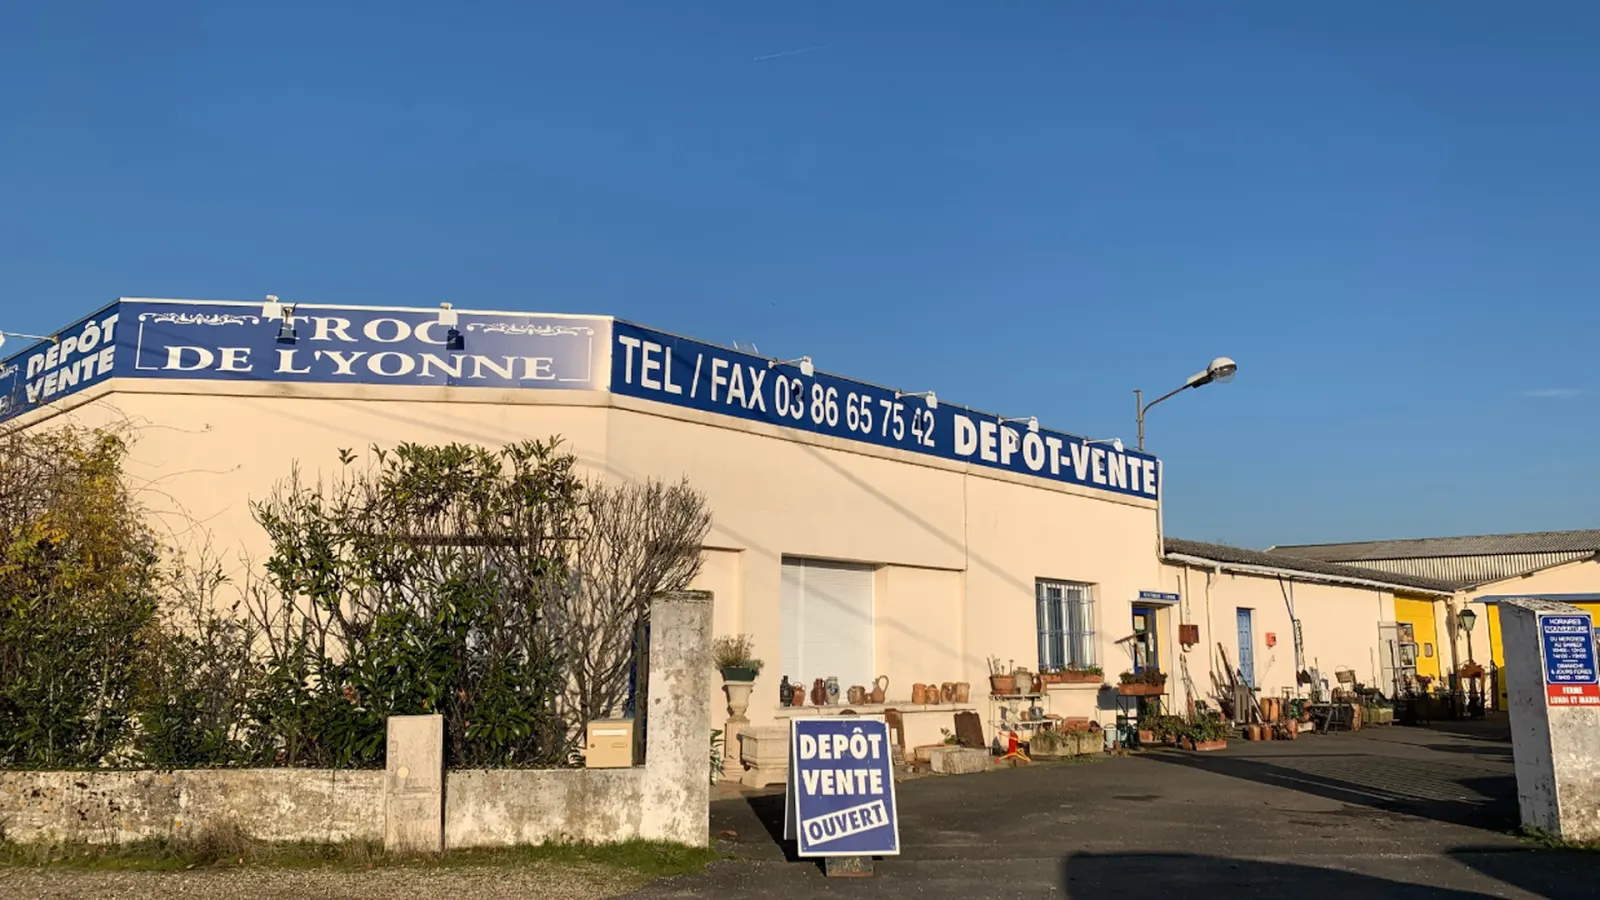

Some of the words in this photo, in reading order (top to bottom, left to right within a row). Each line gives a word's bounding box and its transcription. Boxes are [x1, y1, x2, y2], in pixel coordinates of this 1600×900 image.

[26, 314, 119, 380] DEPÔT
[161, 345, 254, 373] DE
[274, 348, 556, 381] L'YONNE
[25, 345, 116, 404] VENTE
[618, 335, 683, 395] TEL
[690, 353, 703, 398] /
[711, 358, 767, 412] FAX
[775, 375, 805, 420] 03
[811, 383, 839, 427] 86
[846, 392, 873, 434] 65
[880, 399, 905, 441] 75
[912, 407, 935, 447] 42
[799, 727, 882, 760] DEPÔT
[801, 769, 884, 796] VENTE
[808, 804, 883, 841] OUVERT
